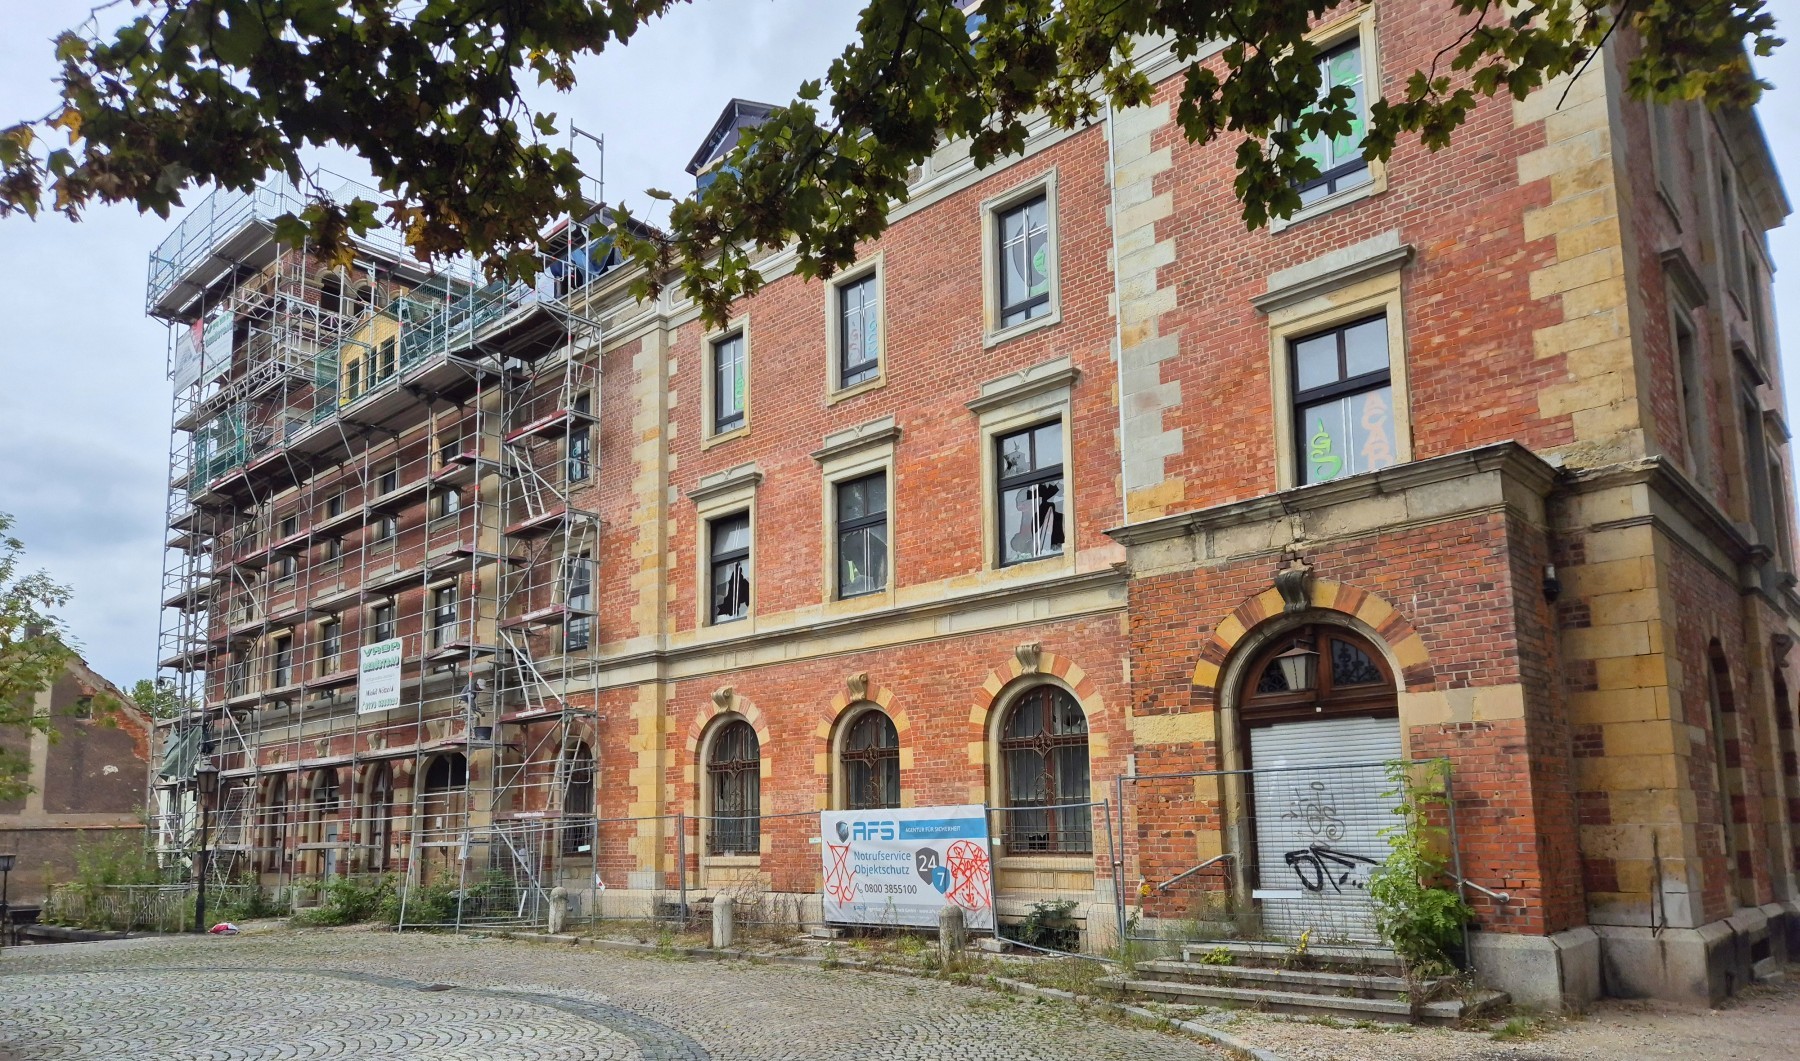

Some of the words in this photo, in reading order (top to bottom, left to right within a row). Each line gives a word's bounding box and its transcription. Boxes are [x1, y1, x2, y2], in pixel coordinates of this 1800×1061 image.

[852, 821, 894, 841] AFS
[854, 850, 911, 861] Notrufservice
[918, 854, 937, 872] 24
[854, 865, 910, 877] Objektschutz
[936, 872, 945, 886] 7
[864, 884, 883, 894] 0800
[884, 884, 917, 895] 3855100
